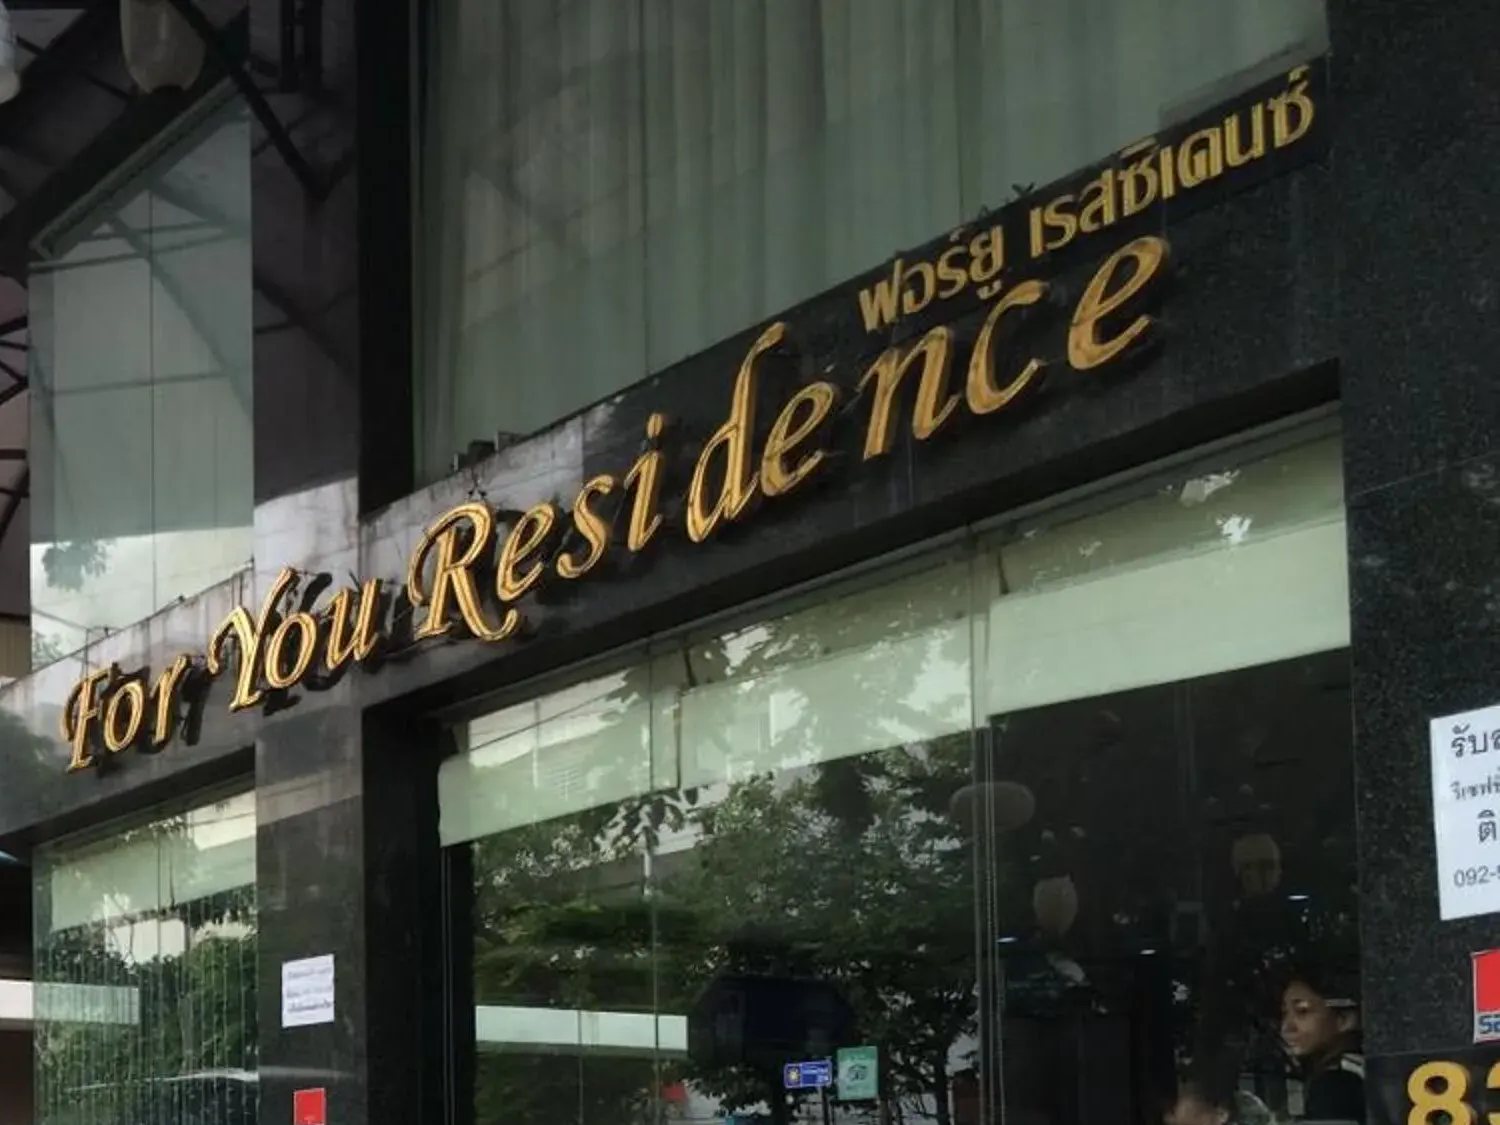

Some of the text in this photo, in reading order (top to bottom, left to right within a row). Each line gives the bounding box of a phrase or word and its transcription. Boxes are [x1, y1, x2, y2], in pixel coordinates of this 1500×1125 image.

[59, 233, 1170, 774] For You Residence
[1453, 865, 1500, 888] 092-
